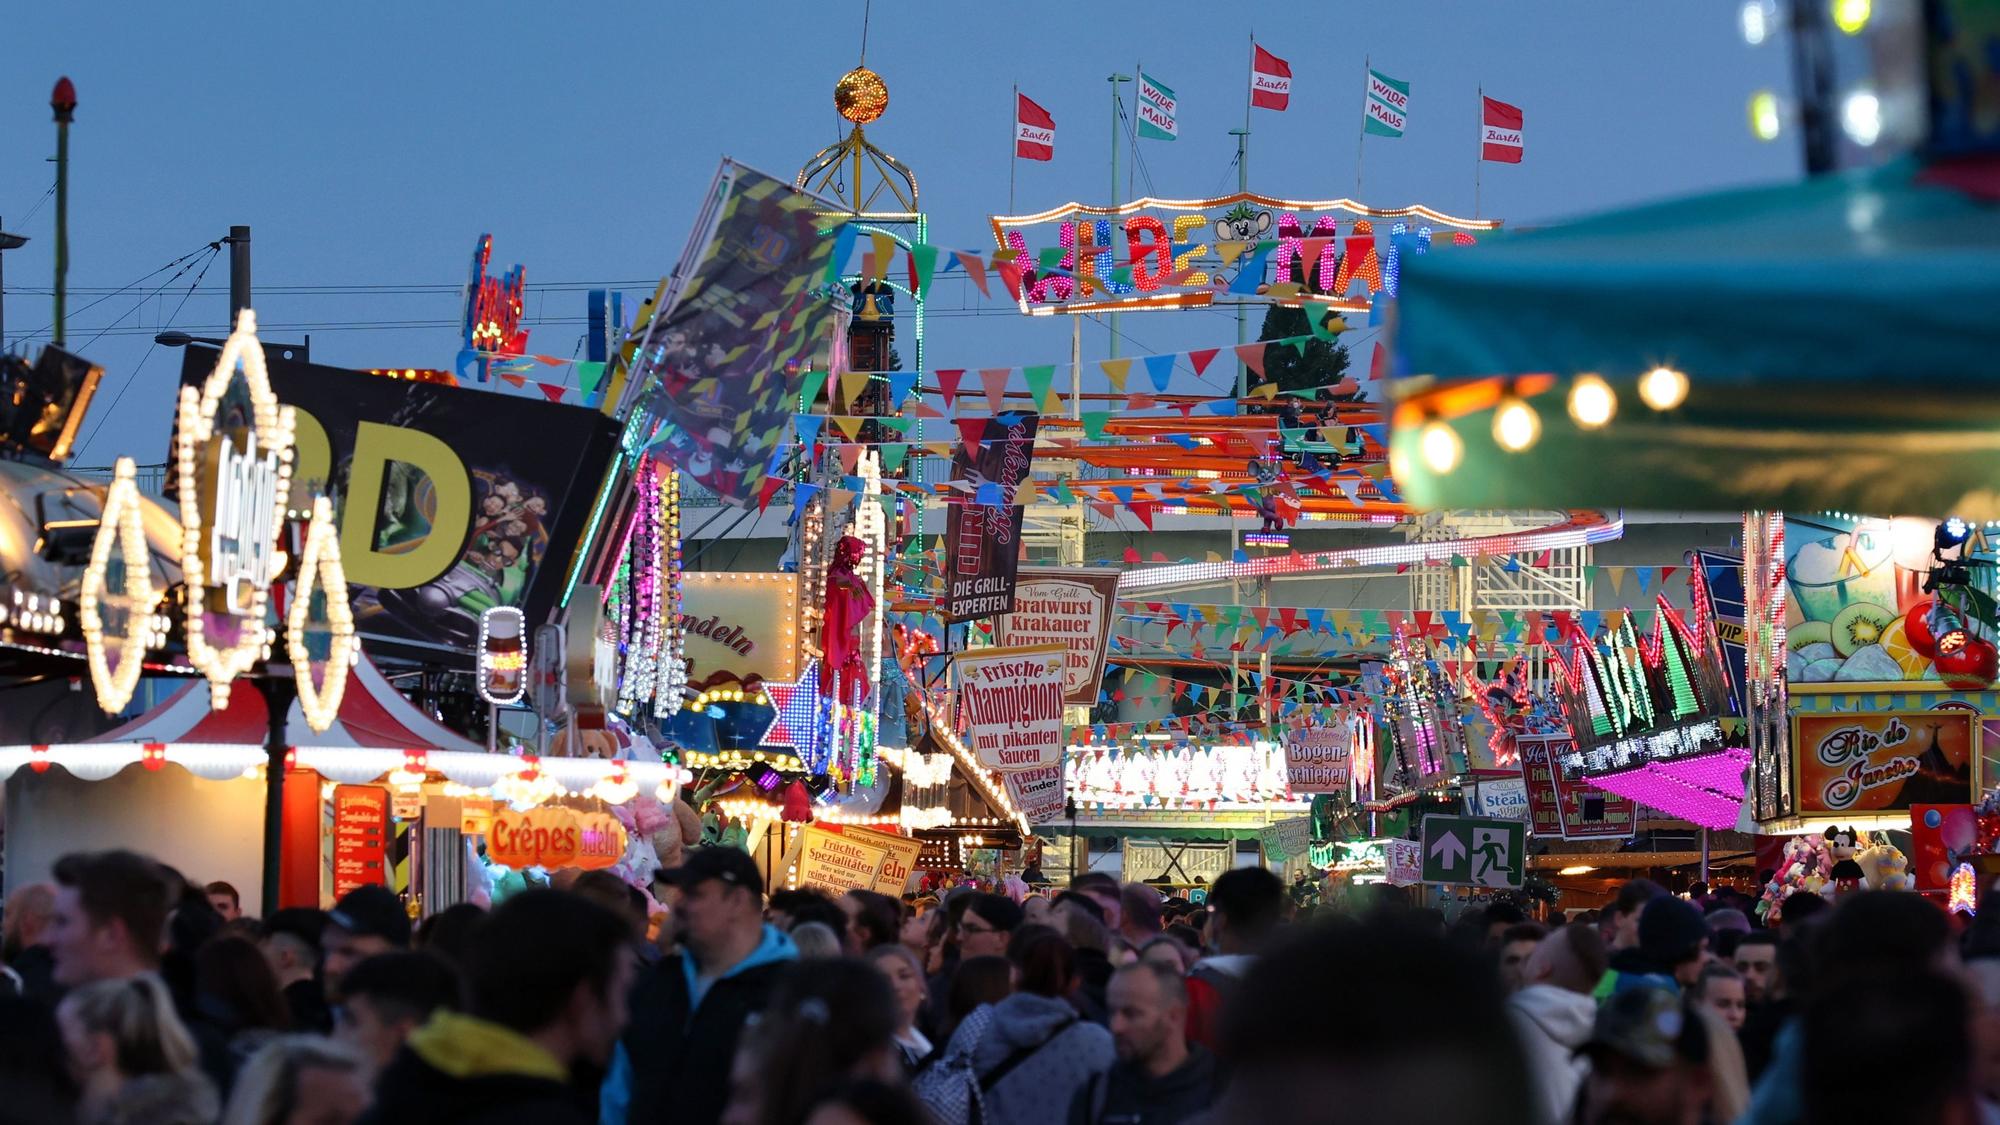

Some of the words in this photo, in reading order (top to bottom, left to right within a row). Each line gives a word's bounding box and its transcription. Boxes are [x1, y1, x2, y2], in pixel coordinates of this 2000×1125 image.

[1256, 77, 1288, 90] Barth
[1373, 79, 1407, 107] WILDE
[1143, 83, 1175, 111] WILDE
[1142, 106, 1174, 130] MAUS
[1371, 103, 1403, 128] MAUS
[1020, 128, 1051, 142] Barth
[1486, 130, 1521, 143] Barth
[1009, 214, 1209, 304] WILDE
[1276, 212, 1477, 298] MAU
[953, 579, 973, 598] DIE
[975, 576, 1011, 596] GRILL-
[1025, 587, 1049, 599] Vom
[952, 595, 1009, 616] EXPERTEN
[1015, 598, 1092, 615] Bratwurst
[1012, 616, 1091, 632] Krakauer
[1718, 622, 1742, 640] VIP
[981, 660, 1044, 683] Frische
[964, 678, 1063, 729] Champignons
[978, 733, 999, 749] mit
[1002, 730, 1058, 749] pikanten
[1818, 727, 1879, 766] Rio
[1883, 720, 1908, 745] de
[998, 748, 1040, 765] Saucen
[1289, 742, 1349, 764] Bogen-
[1012, 766, 1060, 785] CREPES
[1824, 759, 1918, 808] Janeiro
[1486, 793, 1526, 807] Steak
[491, 816, 577, 860] Crêpes
[823, 839, 865, 857] Früchte-
[810, 848, 874, 873] Spezialitäten
[807, 869, 827, 881] reine
[828, 874, 865, 889] Kuvertüre
[878, 875, 902, 887] Zucker
